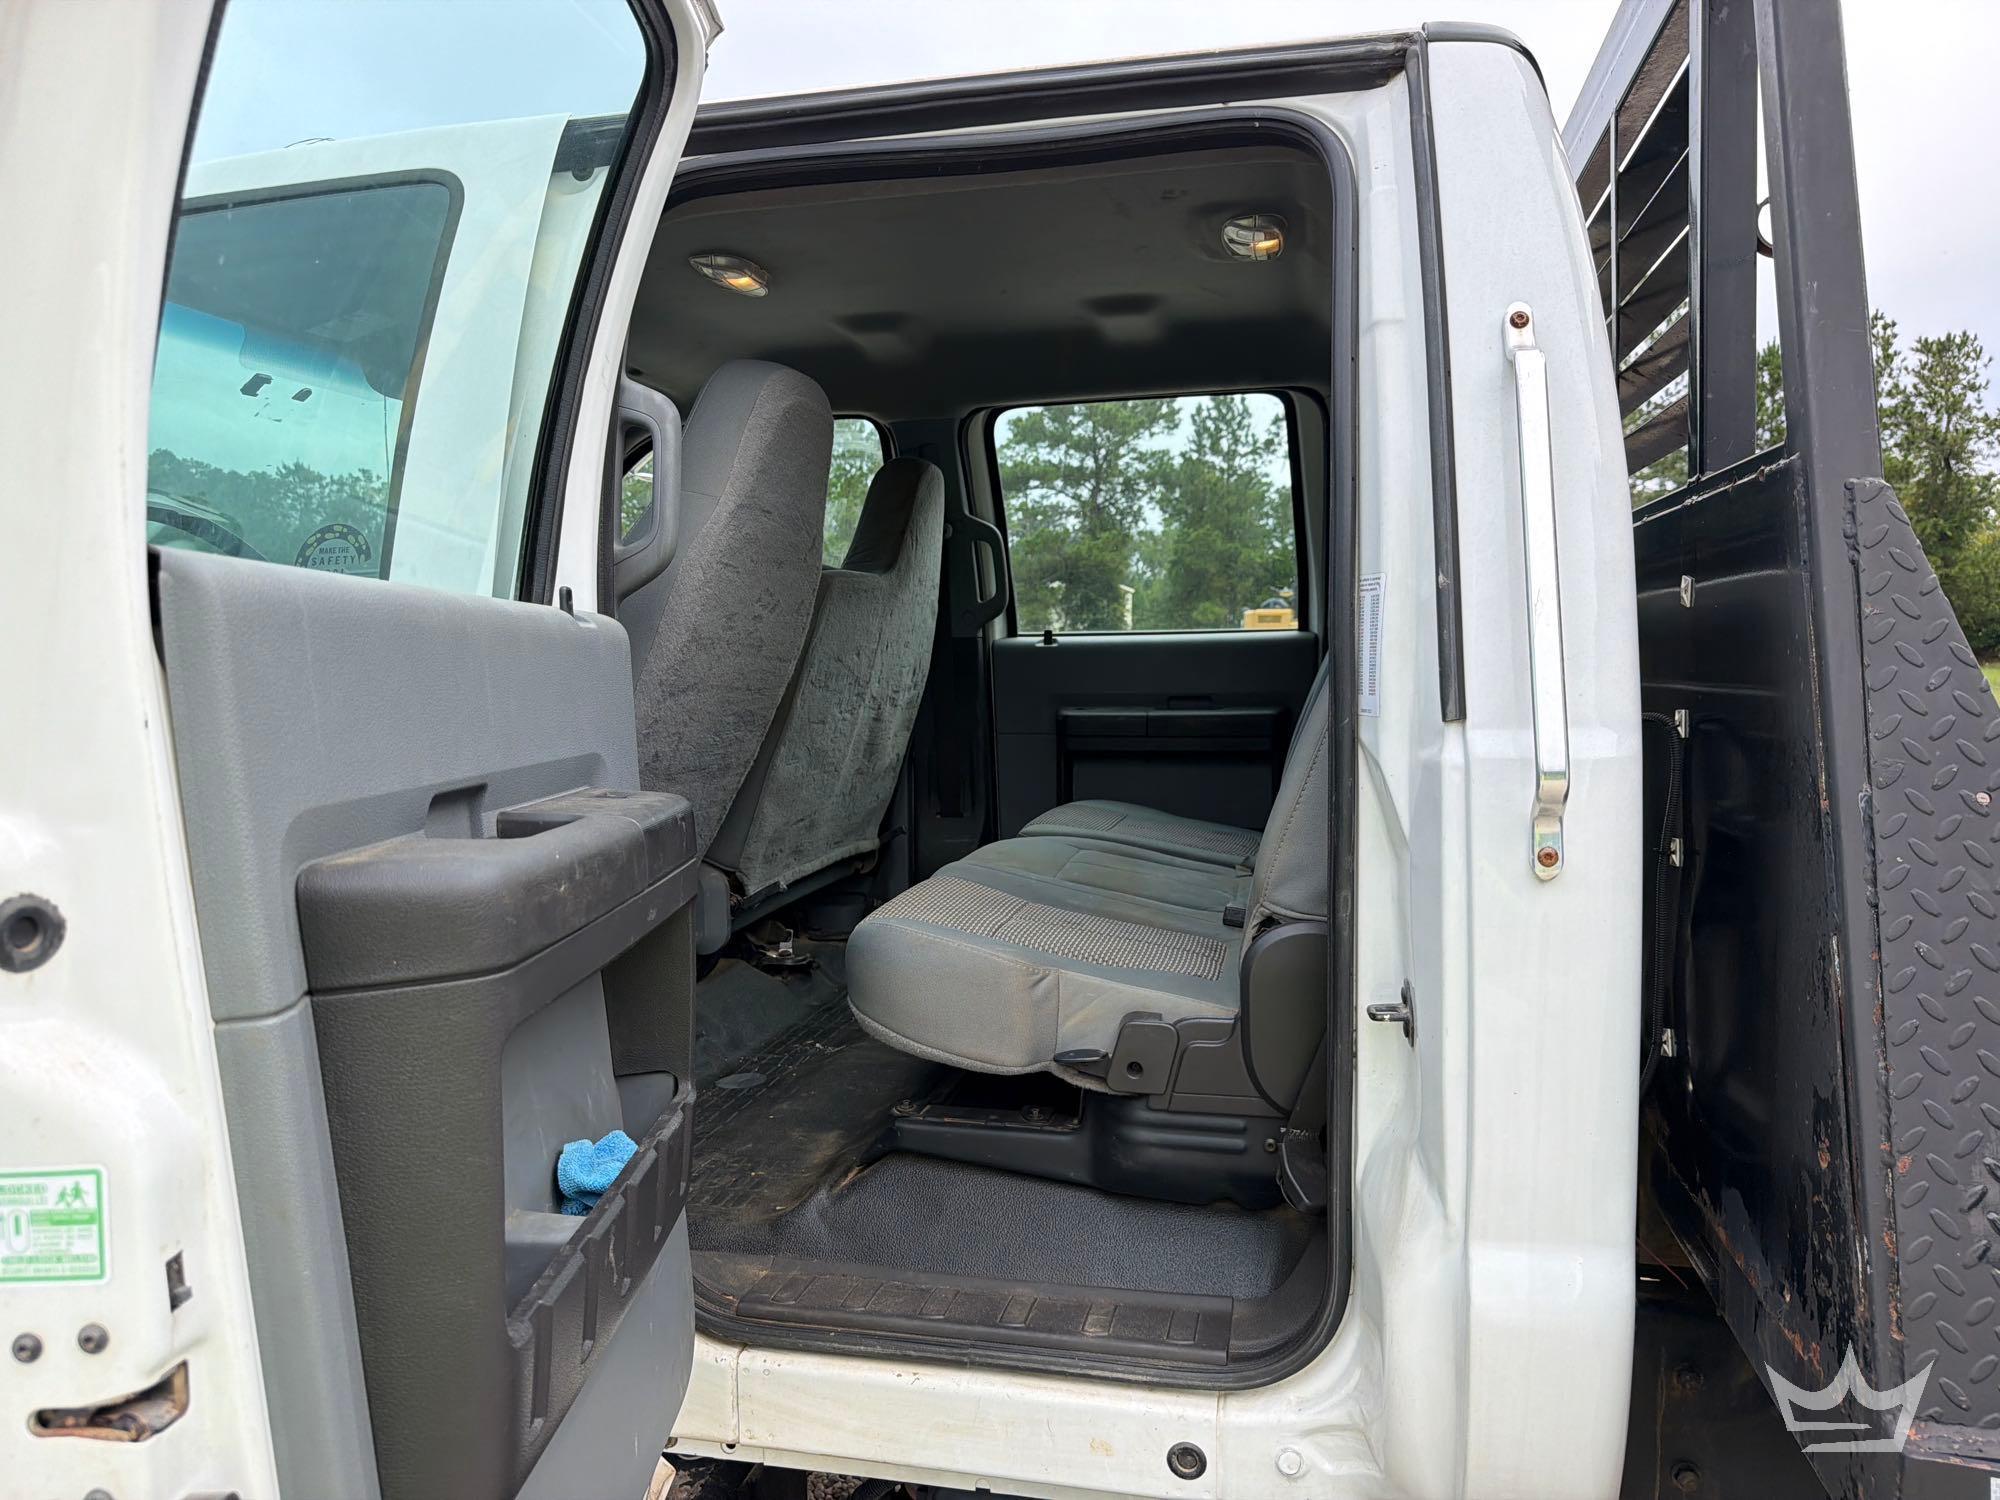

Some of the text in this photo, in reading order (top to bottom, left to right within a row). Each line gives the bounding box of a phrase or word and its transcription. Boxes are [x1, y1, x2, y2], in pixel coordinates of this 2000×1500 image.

[319, 546, 350, 555] MAKE THE
[311, 555, 356, 566] SAFETY
